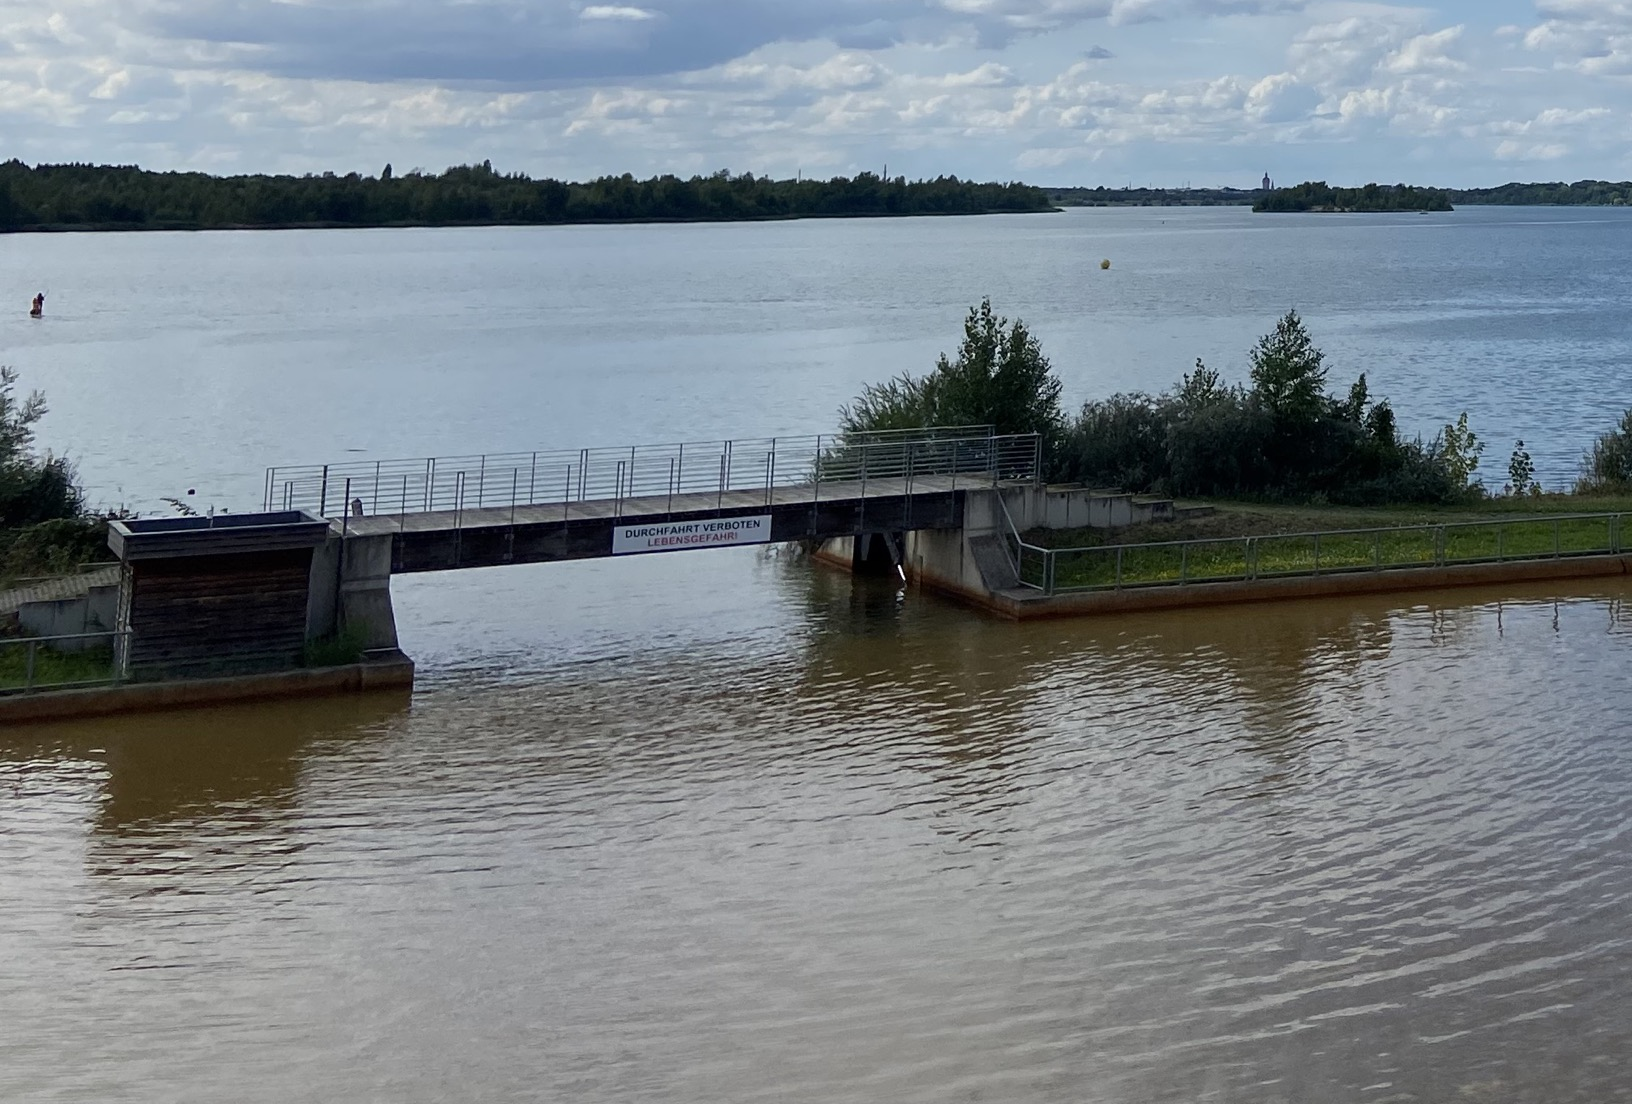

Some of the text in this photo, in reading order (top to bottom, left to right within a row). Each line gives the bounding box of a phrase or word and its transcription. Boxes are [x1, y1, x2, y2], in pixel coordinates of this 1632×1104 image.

[625, 520, 761, 538] DURCHFAHRT VERBOTEN
[648, 531, 738, 547] LEBENSGEFAHR!
